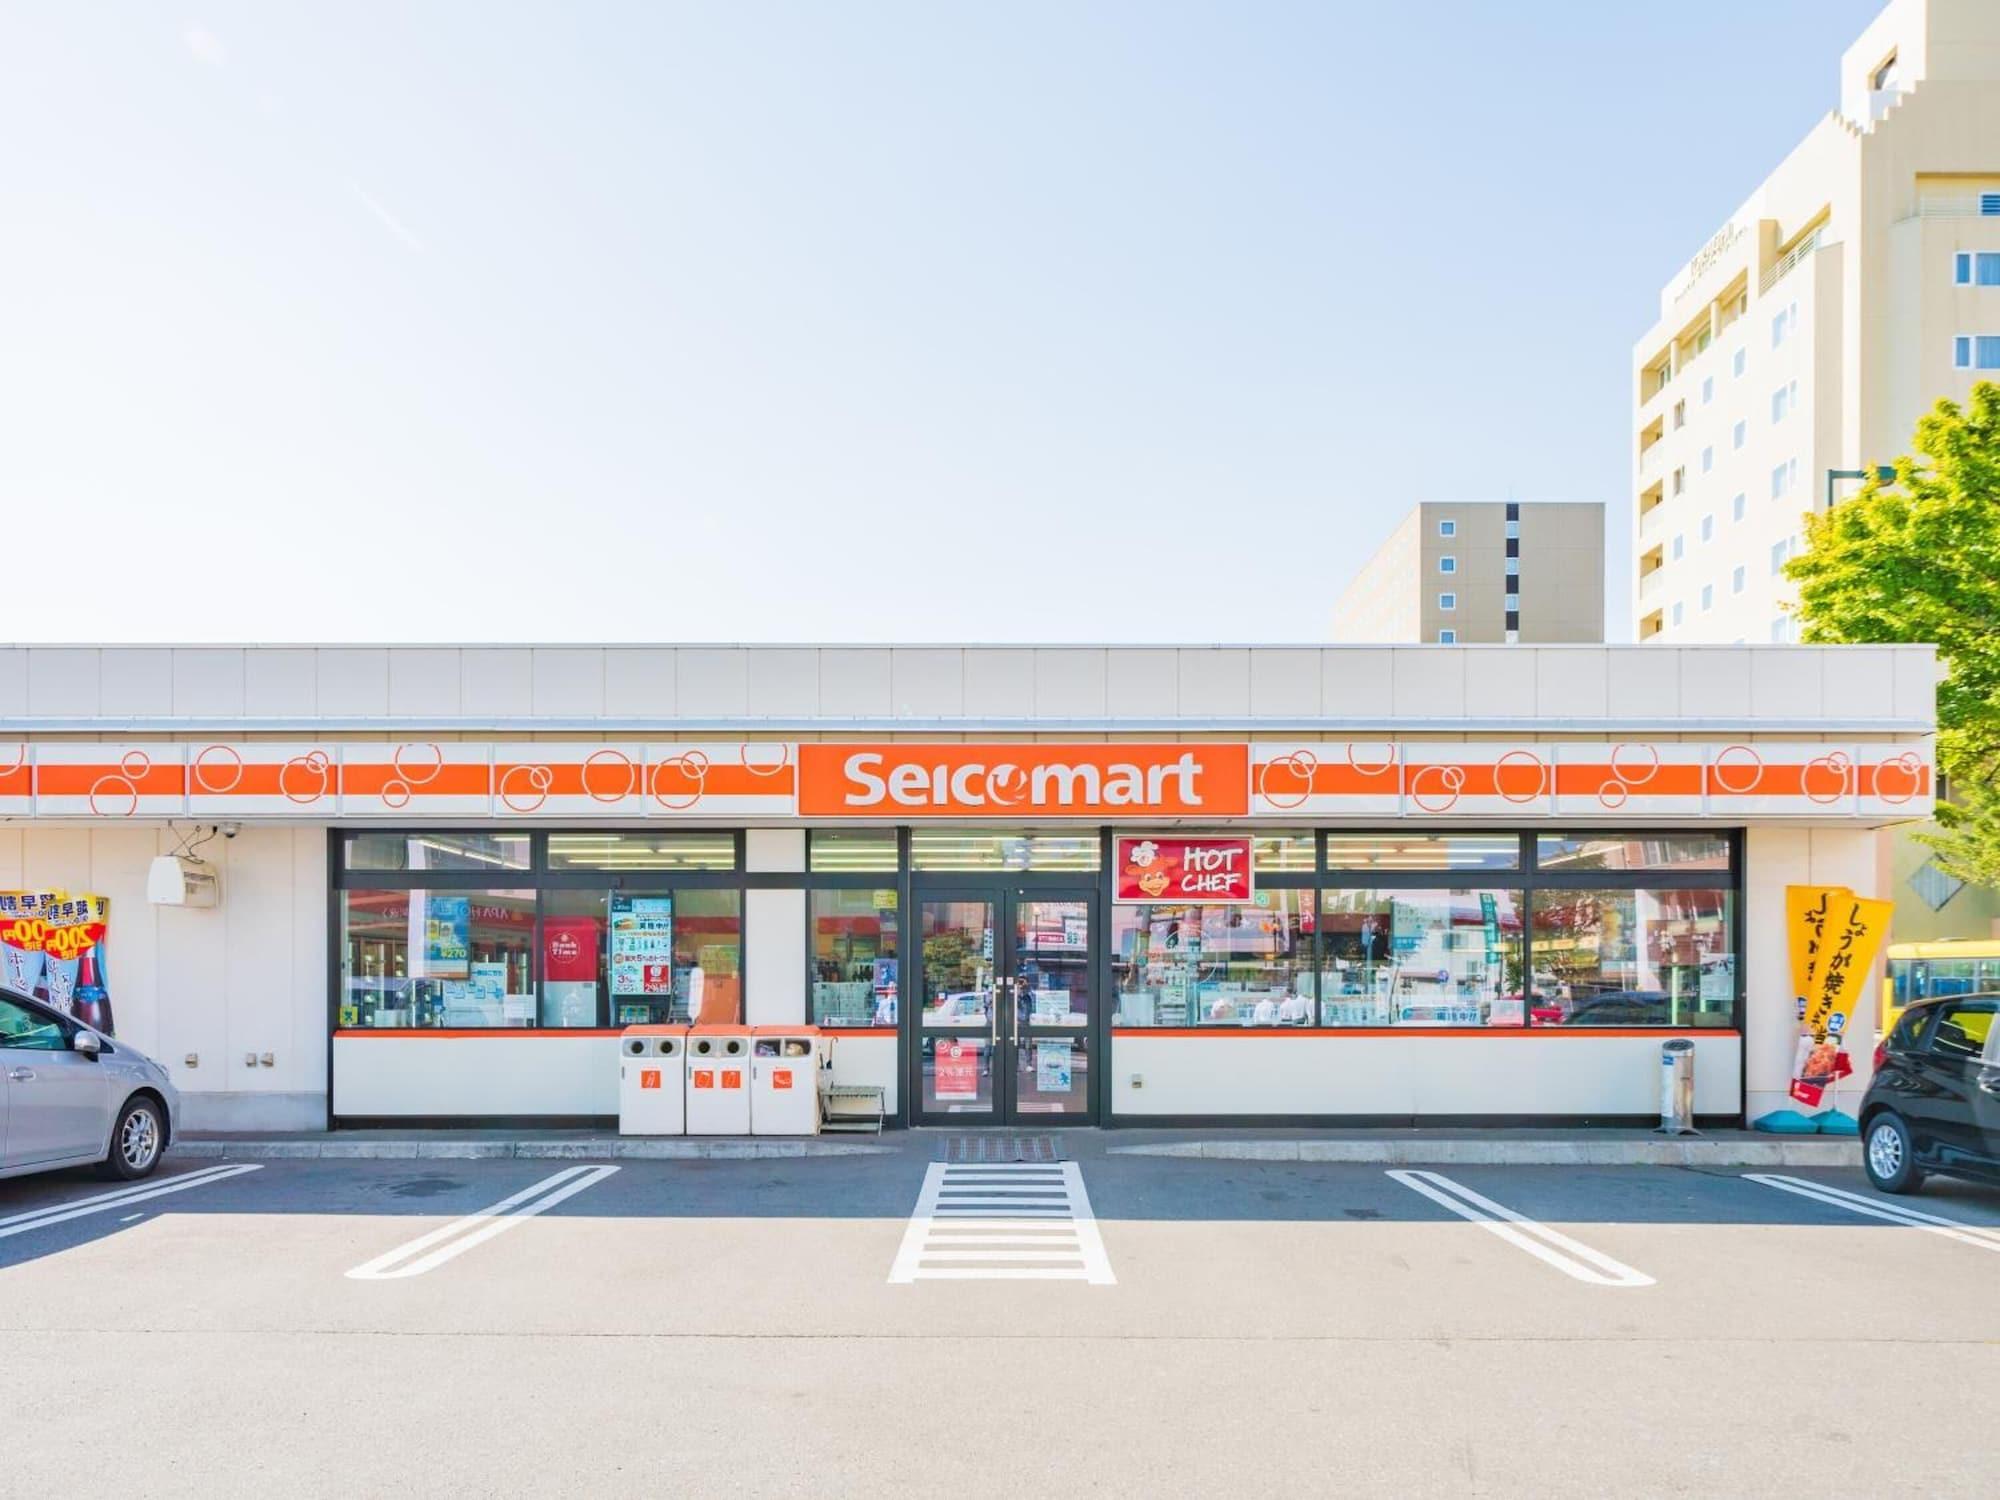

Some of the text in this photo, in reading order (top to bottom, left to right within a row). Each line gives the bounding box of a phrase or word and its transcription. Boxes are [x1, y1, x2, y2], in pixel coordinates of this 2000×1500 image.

[844, 753, 1203, 806] Seicomart
[1183, 846, 1244, 872] HOT
[1181, 872, 1242, 893] CHEF
